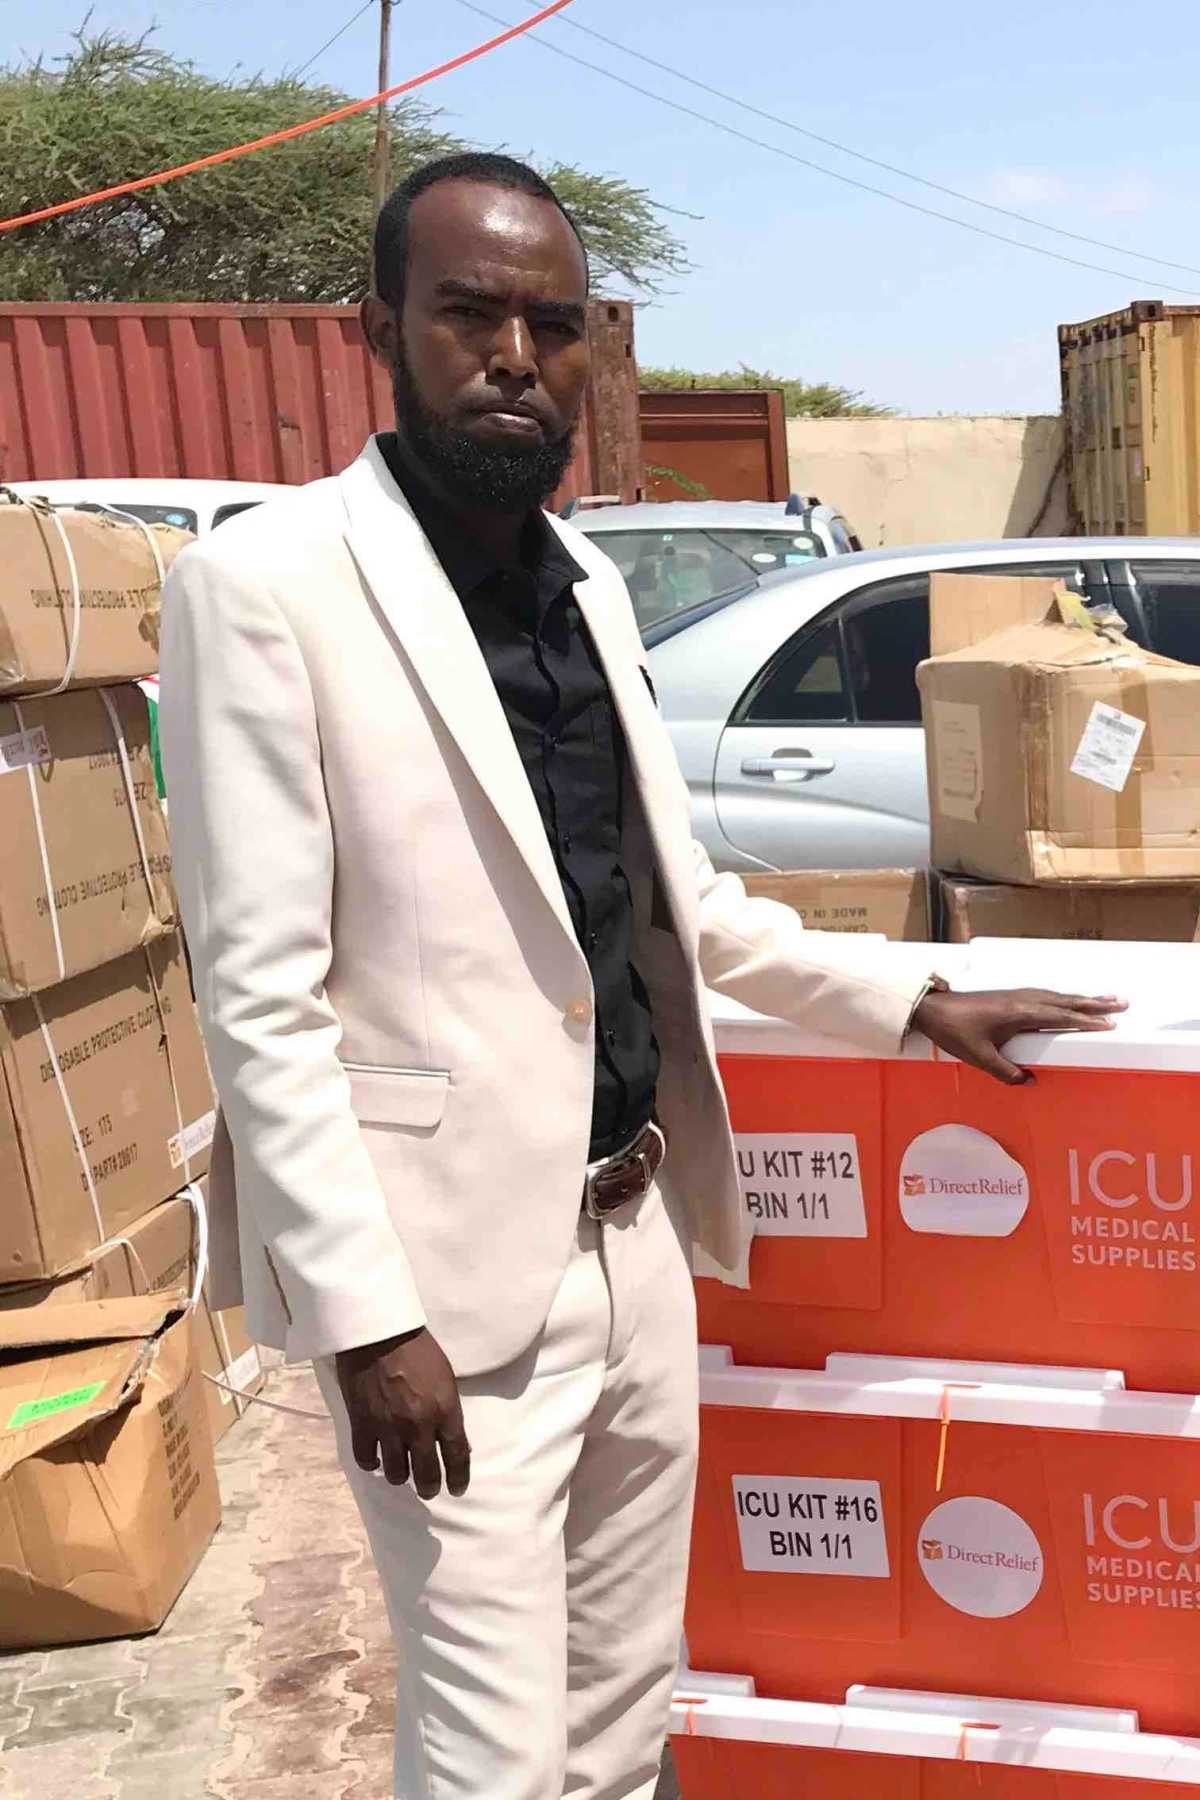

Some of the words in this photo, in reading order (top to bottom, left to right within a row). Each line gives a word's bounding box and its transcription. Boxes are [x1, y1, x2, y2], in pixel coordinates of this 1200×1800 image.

[814, 908, 826, 919] IN
[831, 907, 867, 919] MADE
[91, 1015, 138, 1054] PROTECTIVE
[763, 1150, 803, 1178] KIT
[810, 1150, 854, 1179] #12
[1068, 1148, 1193, 1212] ICU
[745, 1191, 788, 1219] BIN
[796, 1192, 829, 1219] 1/1
[1071, 1216, 1196, 1244] MEDICAL
[1072, 1244, 1197, 1272] SUPPLIES
[737, 1491, 780, 1518] ICU
[788, 1493, 827, 1520] KIT
[835, 1495, 878, 1523] #16
[769, 1531, 812, 1558] BIN
[821, 1533, 853, 1560] 1/1
